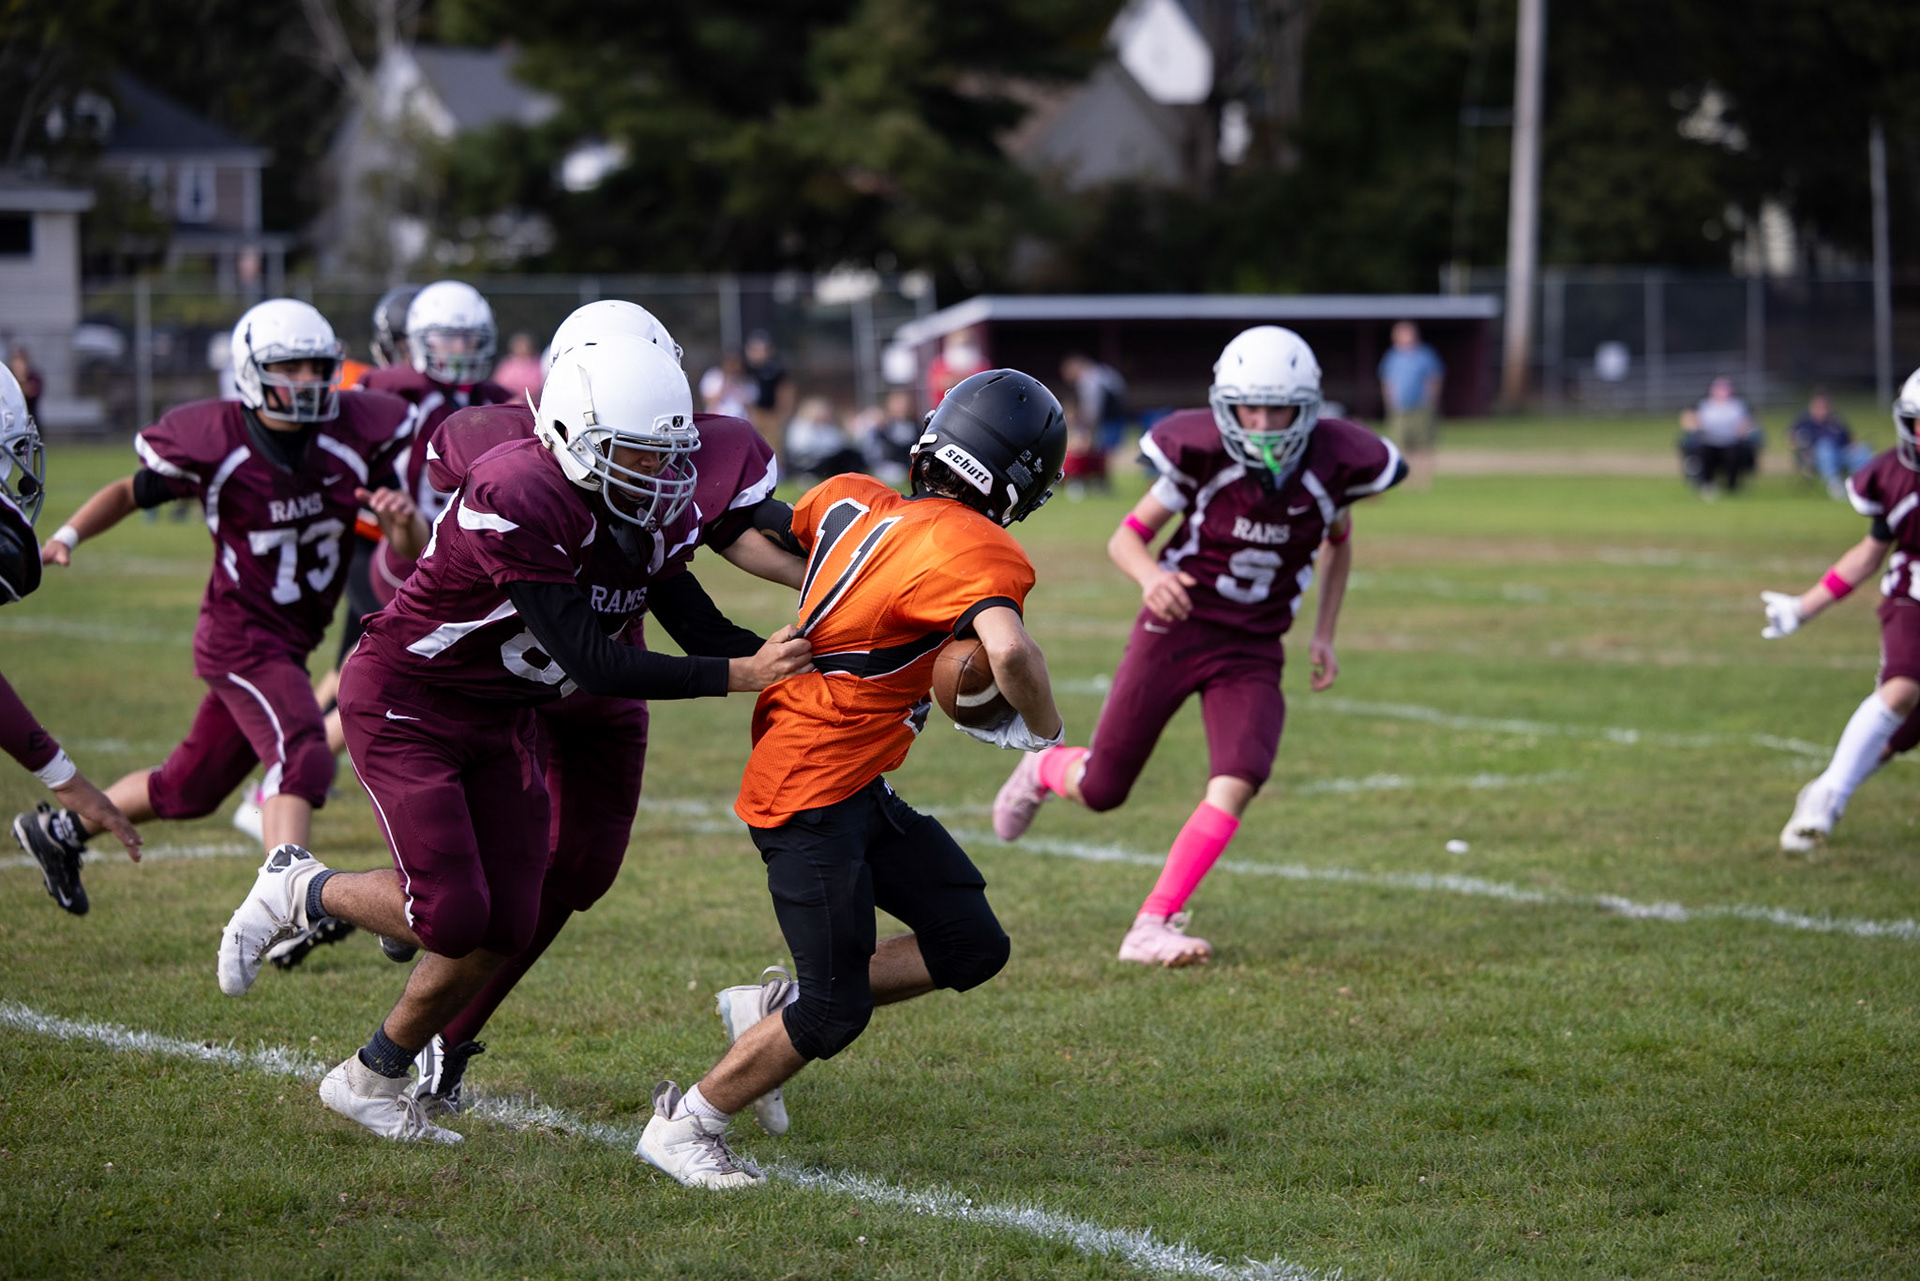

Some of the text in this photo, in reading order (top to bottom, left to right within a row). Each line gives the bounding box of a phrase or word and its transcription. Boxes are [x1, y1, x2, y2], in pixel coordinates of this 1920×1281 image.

[945, 449, 990, 484] schutt
[268, 492, 324, 523] RAMS
[1231, 515, 1290, 545] RAMS
[248, 518, 346, 605] 73
[789, 497, 904, 639] 11
[1215, 548, 1283, 604] 9
[590, 584, 648, 613] RAMS
